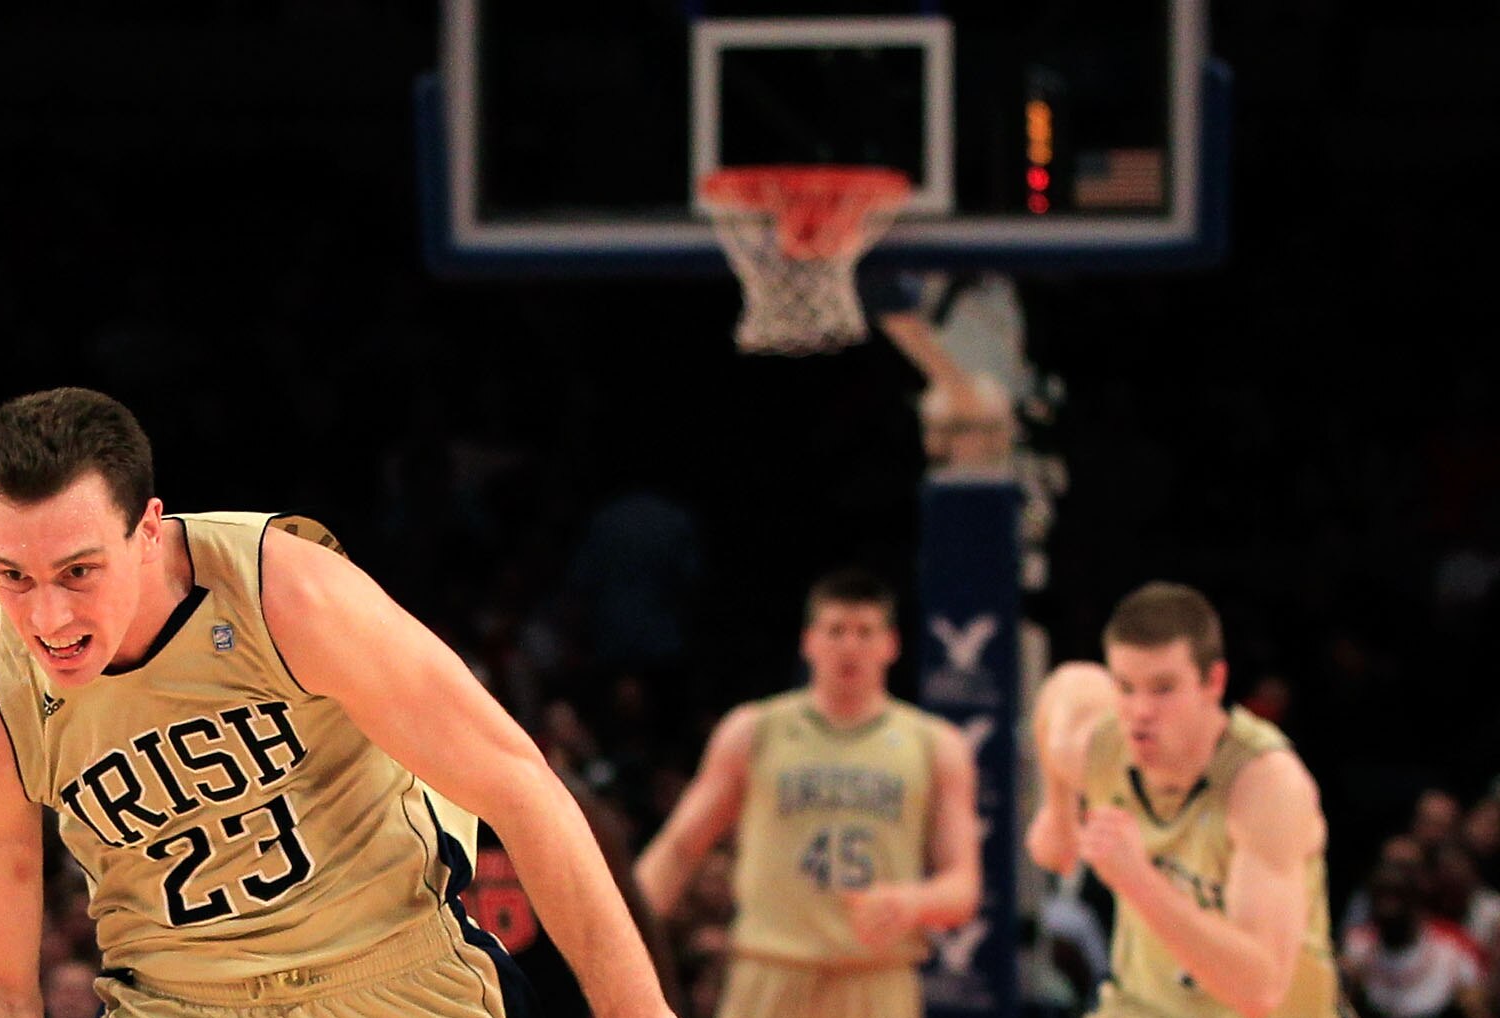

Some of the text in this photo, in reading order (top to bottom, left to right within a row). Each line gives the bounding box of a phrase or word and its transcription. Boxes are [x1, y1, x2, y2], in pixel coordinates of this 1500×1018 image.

[59, 701, 309, 849] IRISH
[144, 794, 315, 928] 23
[800, 828, 874, 891] 45
